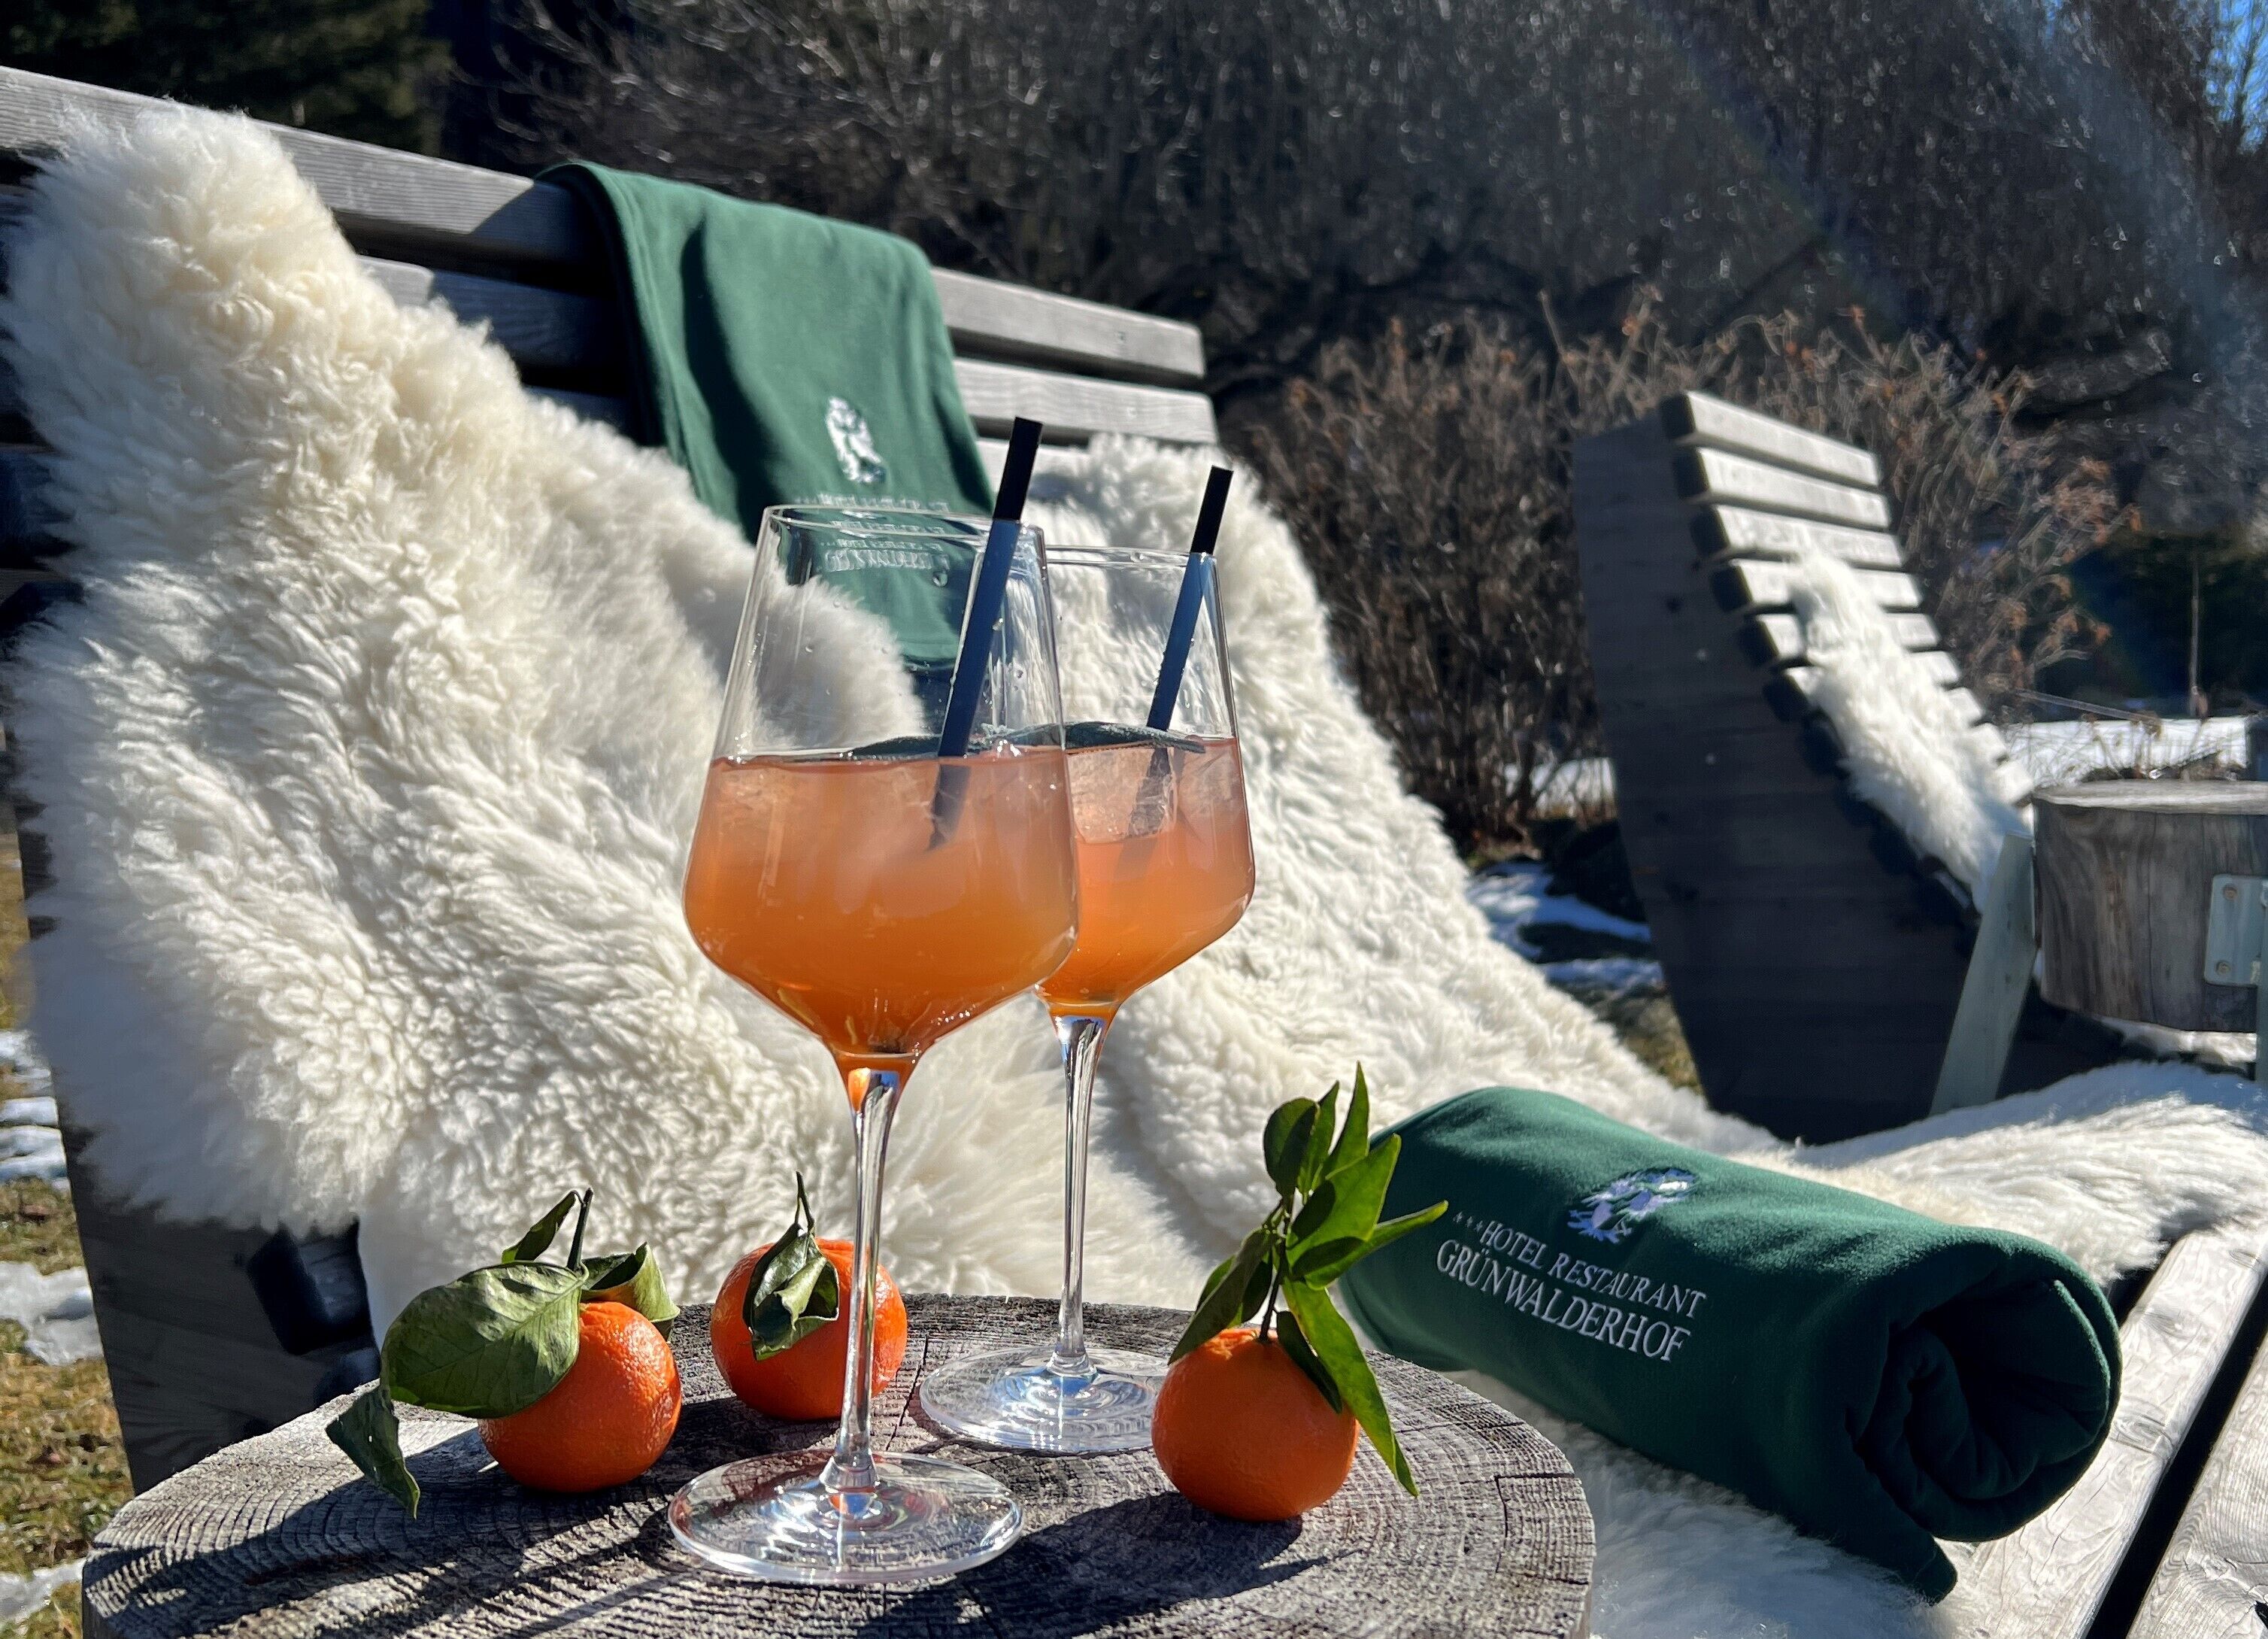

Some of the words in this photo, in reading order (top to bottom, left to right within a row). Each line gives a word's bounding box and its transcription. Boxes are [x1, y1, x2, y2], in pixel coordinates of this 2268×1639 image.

[1436, 1240, 1690, 1361] GRÜNWALDERHOF
[1480, 1220, 1547, 1269] HOTEL
[1548, 1252, 1707, 1319] RESTAURANT
